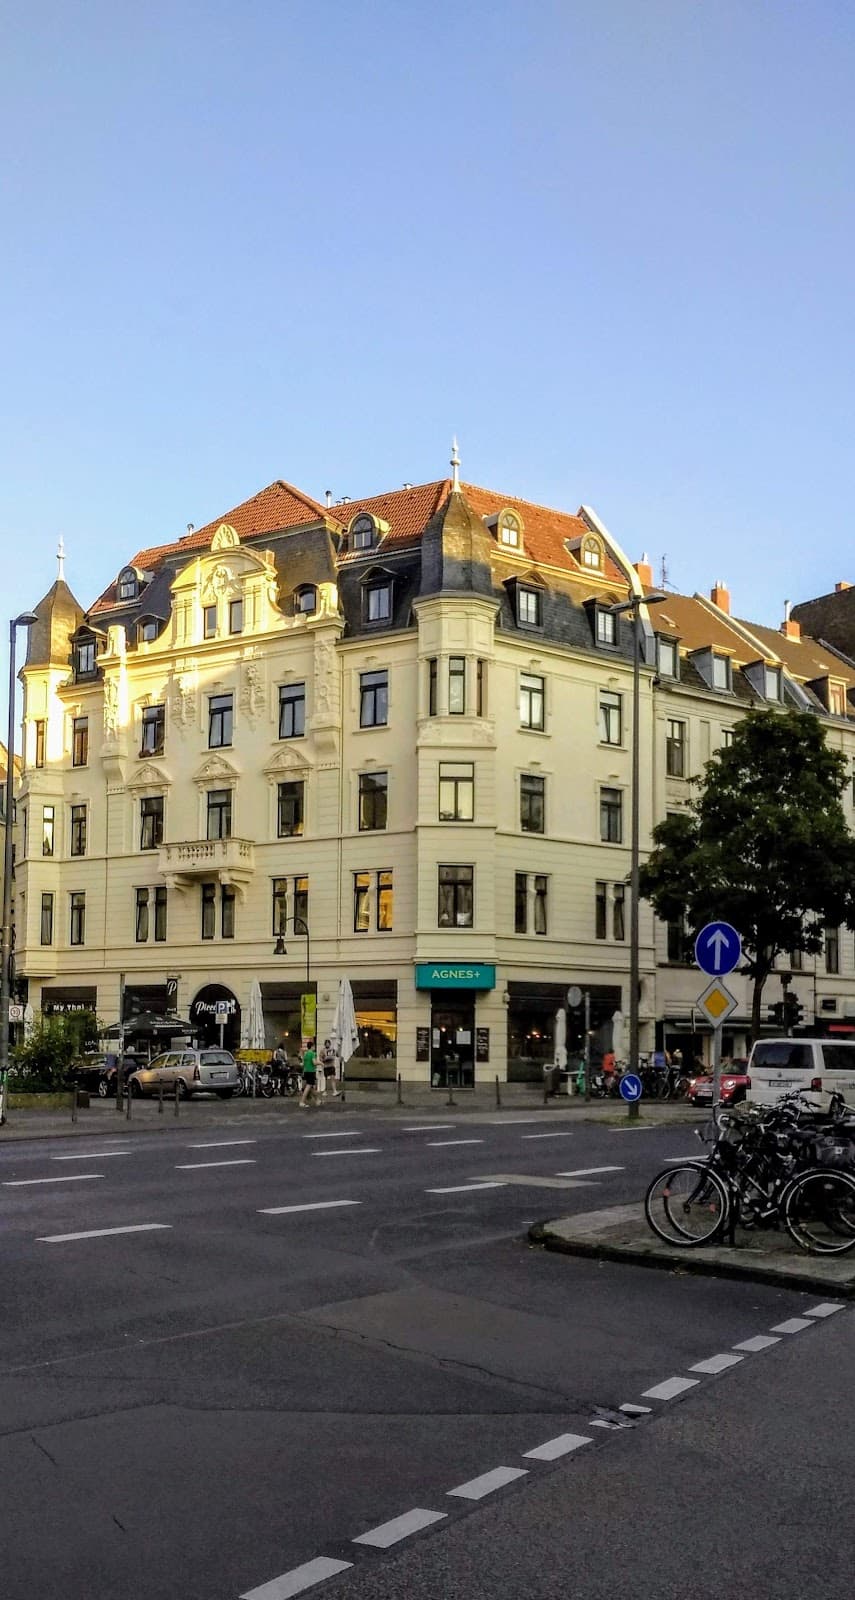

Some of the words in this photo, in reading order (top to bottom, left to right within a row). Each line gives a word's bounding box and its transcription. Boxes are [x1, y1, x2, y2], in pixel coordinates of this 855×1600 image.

[431, 969, 481, 979] AGNES+
[167, 980, 177, 996] P
[217, 1003, 226, 1013] P
